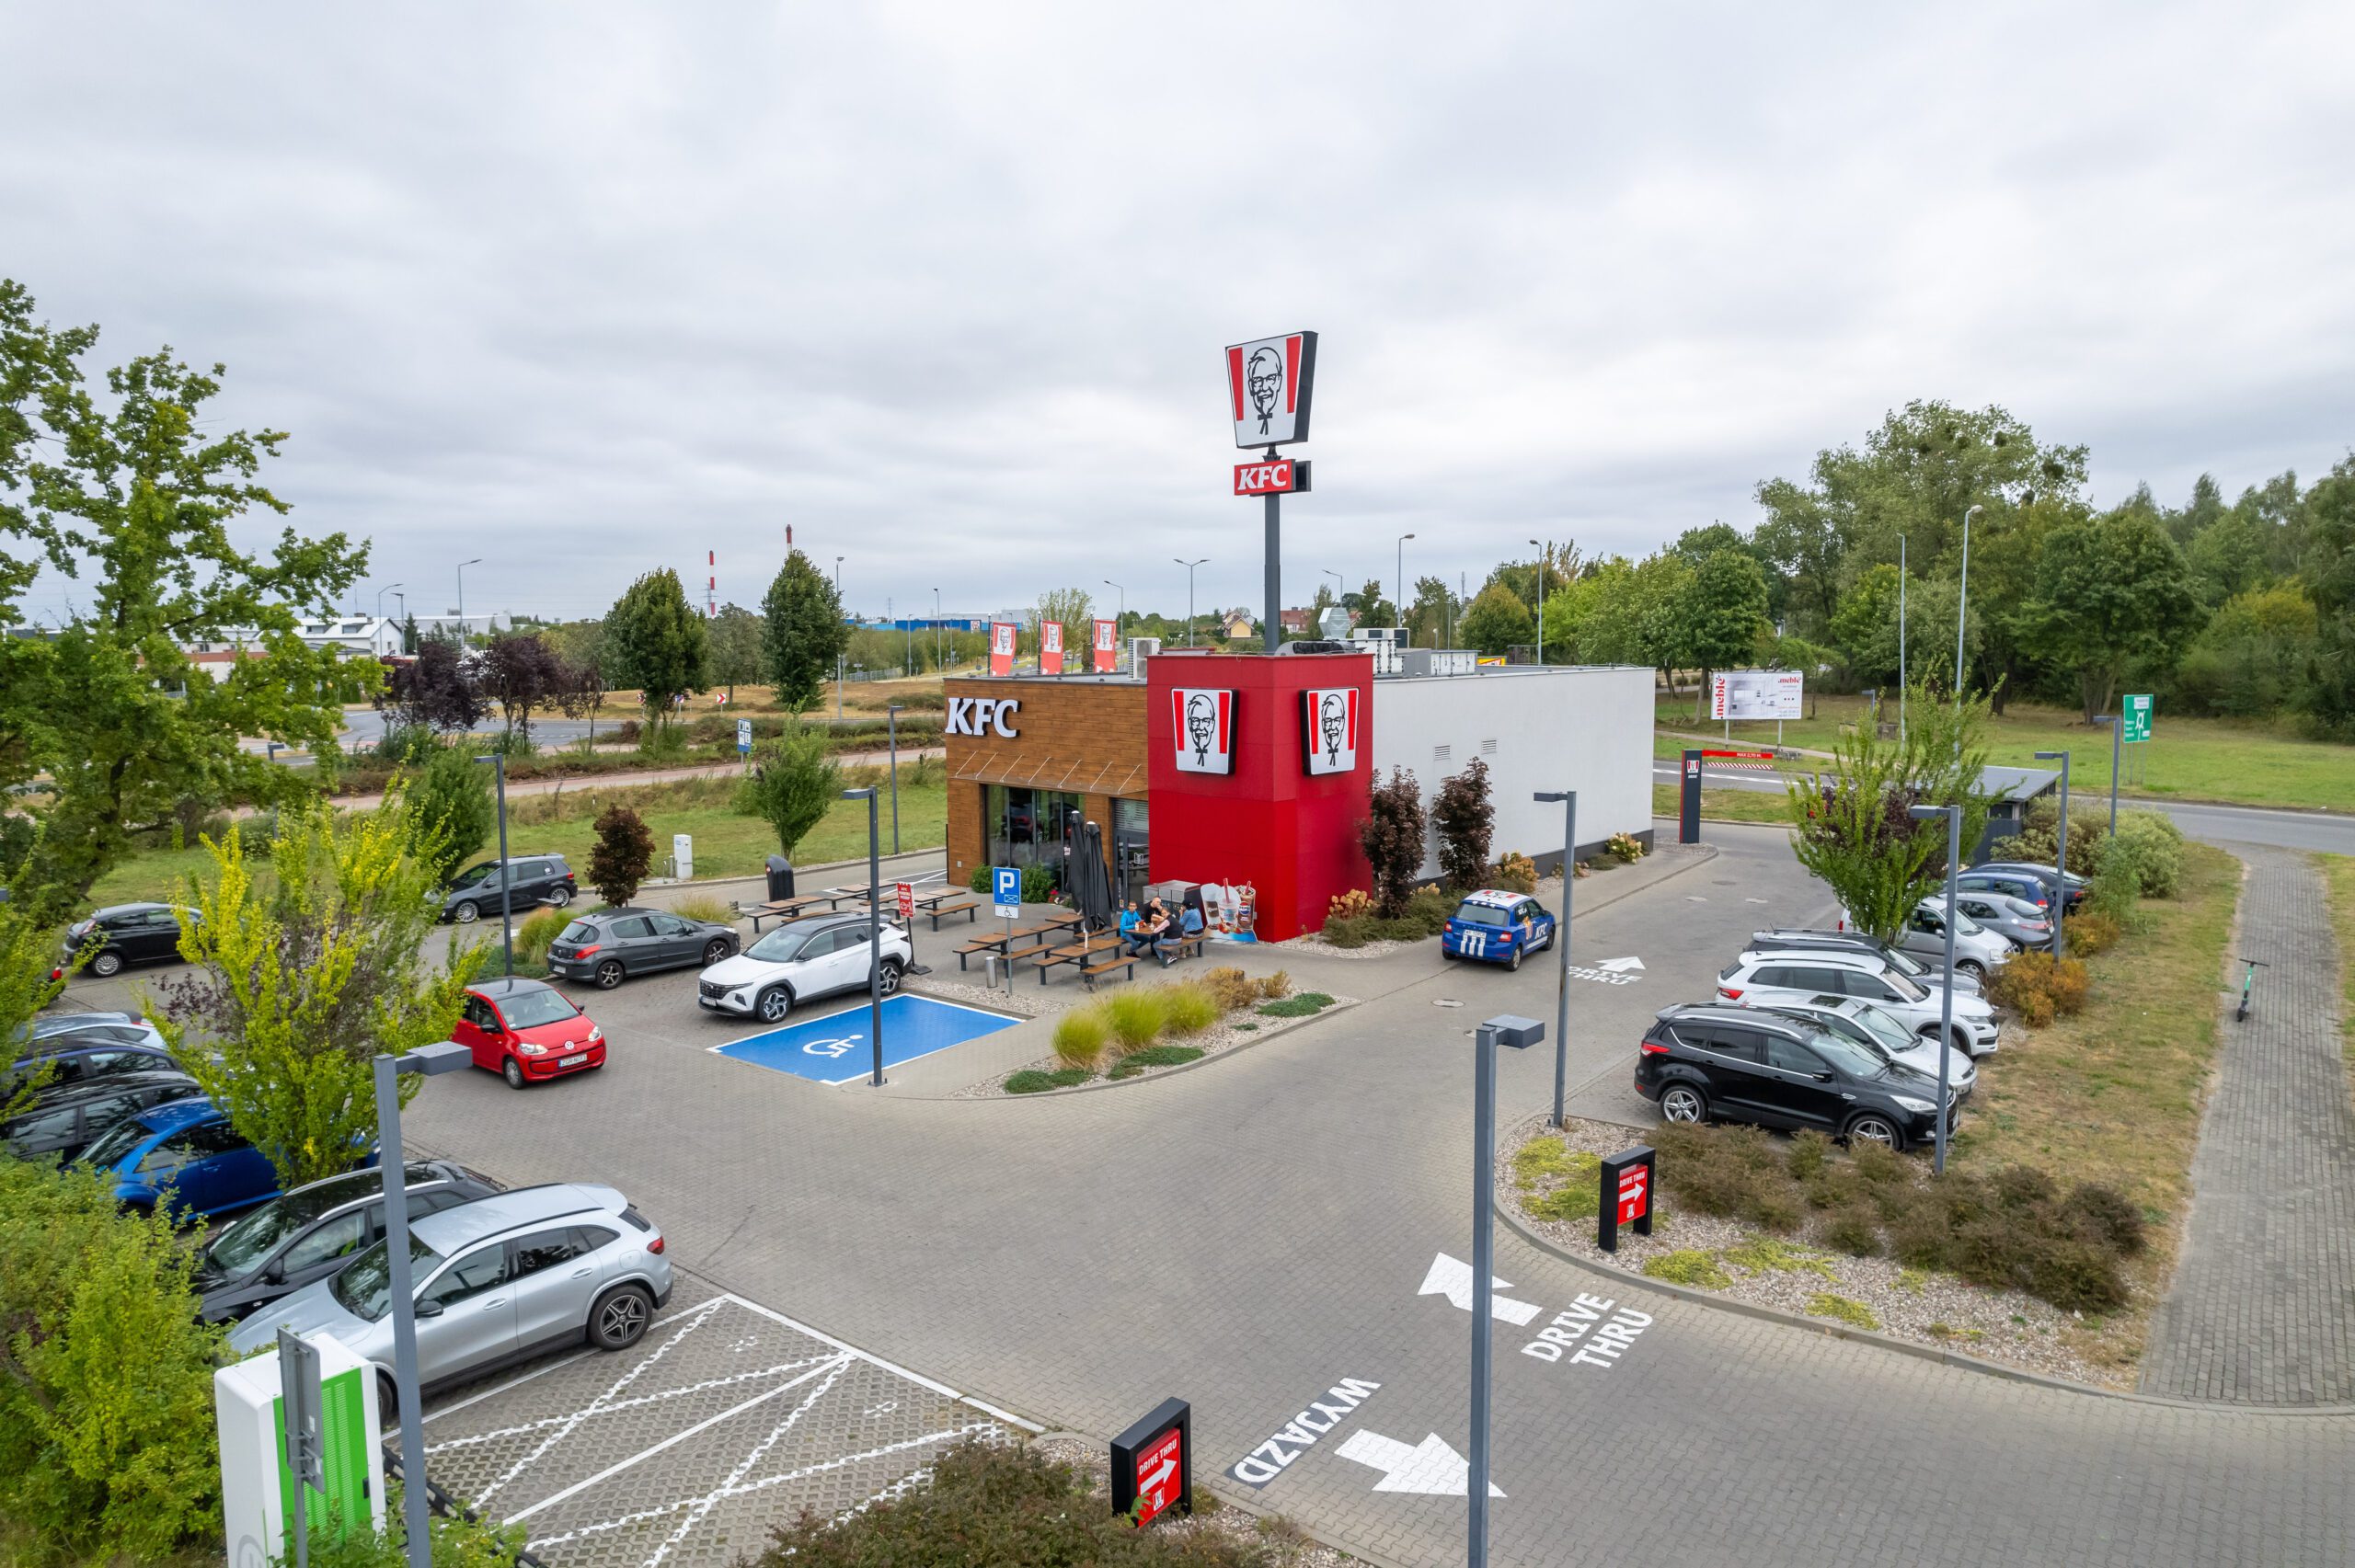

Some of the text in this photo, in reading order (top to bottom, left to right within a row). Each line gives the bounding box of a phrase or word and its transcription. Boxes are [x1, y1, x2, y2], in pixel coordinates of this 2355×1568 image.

[1238, 464, 1288, 490] KFC
[946, 697, 1020, 738] KFC
[1000, 871, 1015, 894] P
[1534, 922, 1548, 939] KFC
[1569, 966, 1643, 981] DRIVE
[1620, 1172, 1645, 1188] DRIVE THRU
[1521, 1292, 1615, 1363] DRIVE
[1569, 1308, 1653, 1368] THRU
[1235, 1378, 1381, 1482] WYJAZD
[1139, 1438, 1177, 1476] DRIVE THRU
